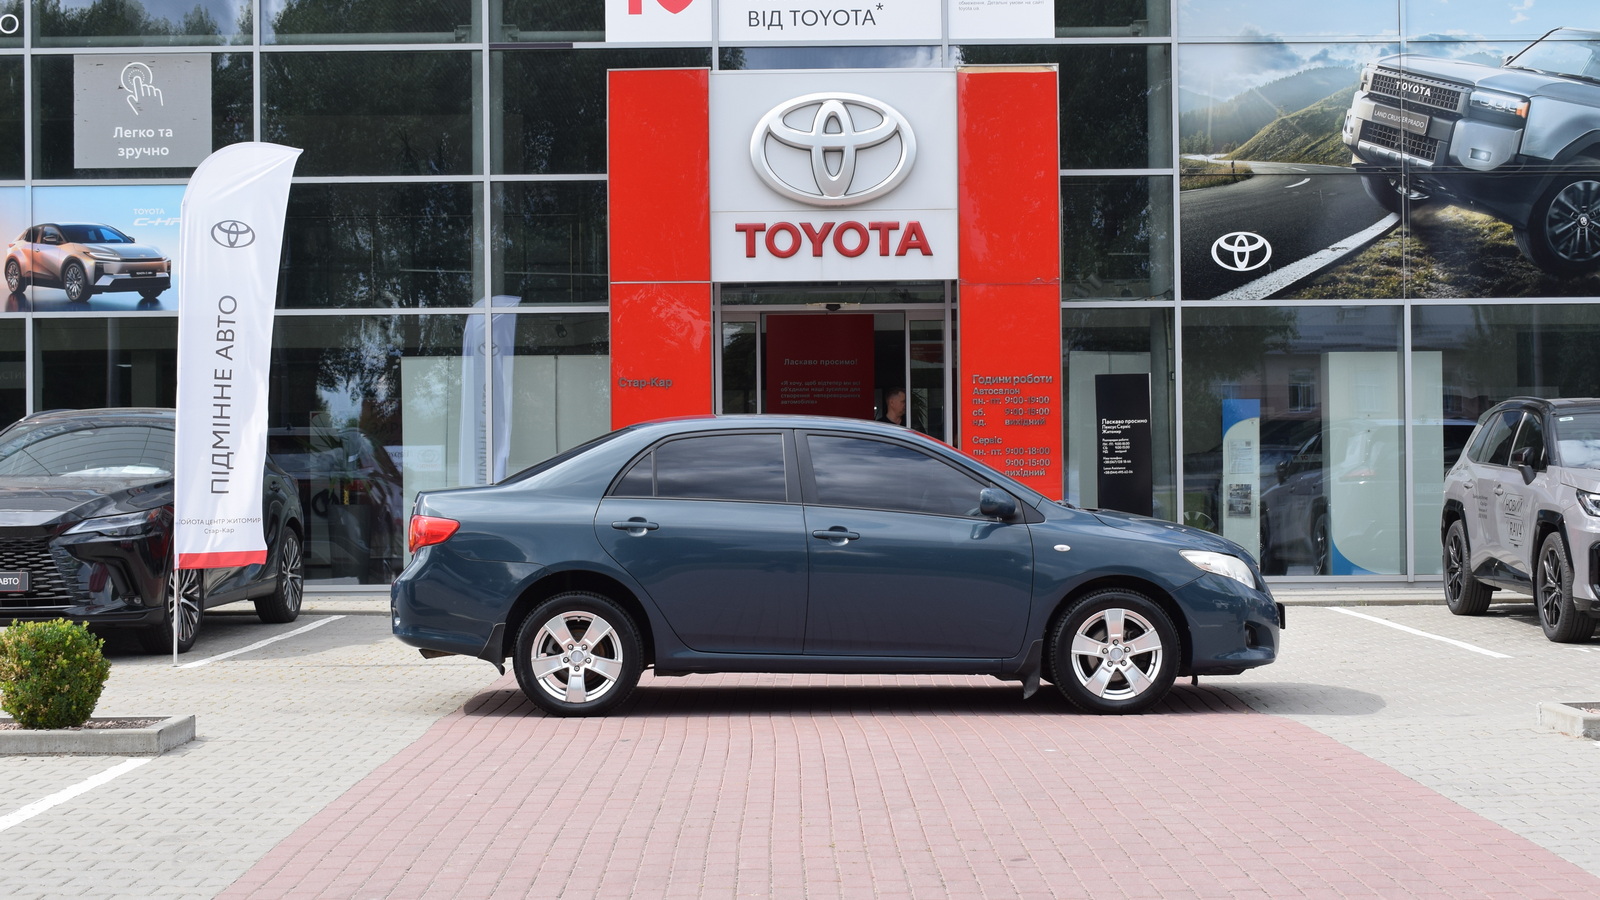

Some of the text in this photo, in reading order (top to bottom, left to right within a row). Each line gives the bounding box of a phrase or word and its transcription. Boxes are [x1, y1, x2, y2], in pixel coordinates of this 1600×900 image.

[748, 11, 783, 31] ВІД
[1396, 81, 1431, 97] TOYOTA
[1374, 110, 1388, 119] LAND
[1407, 118, 1425, 129] PRADO
[113, 126, 173, 138] Легко та
[118, 146, 169, 160] зручно
[735, 220, 934, 259] TOYOTA
[784, 358, 818, 366] Ласкаво
[618, 376, 674, 390] Стар-Кар
[972, 374, 1053, 387] Години роботи
[211, 295, 237, 493] ПІДМІННЕ АВТО
[973, 387, 1021, 396] Автосалон
[1005, 396, 1050, 404] 9:00-19:00
[972, 407, 986, 417] сб.
[1005, 416, 1046, 427] вихідний
[972, 435, 1003, 447] Сервіс
[1005, 446, 1051, 456] 9:00-18:00
[1005, 458, 1051, 467] 9:00-15:00
[205, 518, 226, 526] ЦЕНТР
[226, 516, 262, 525] ЖИТОМИР
